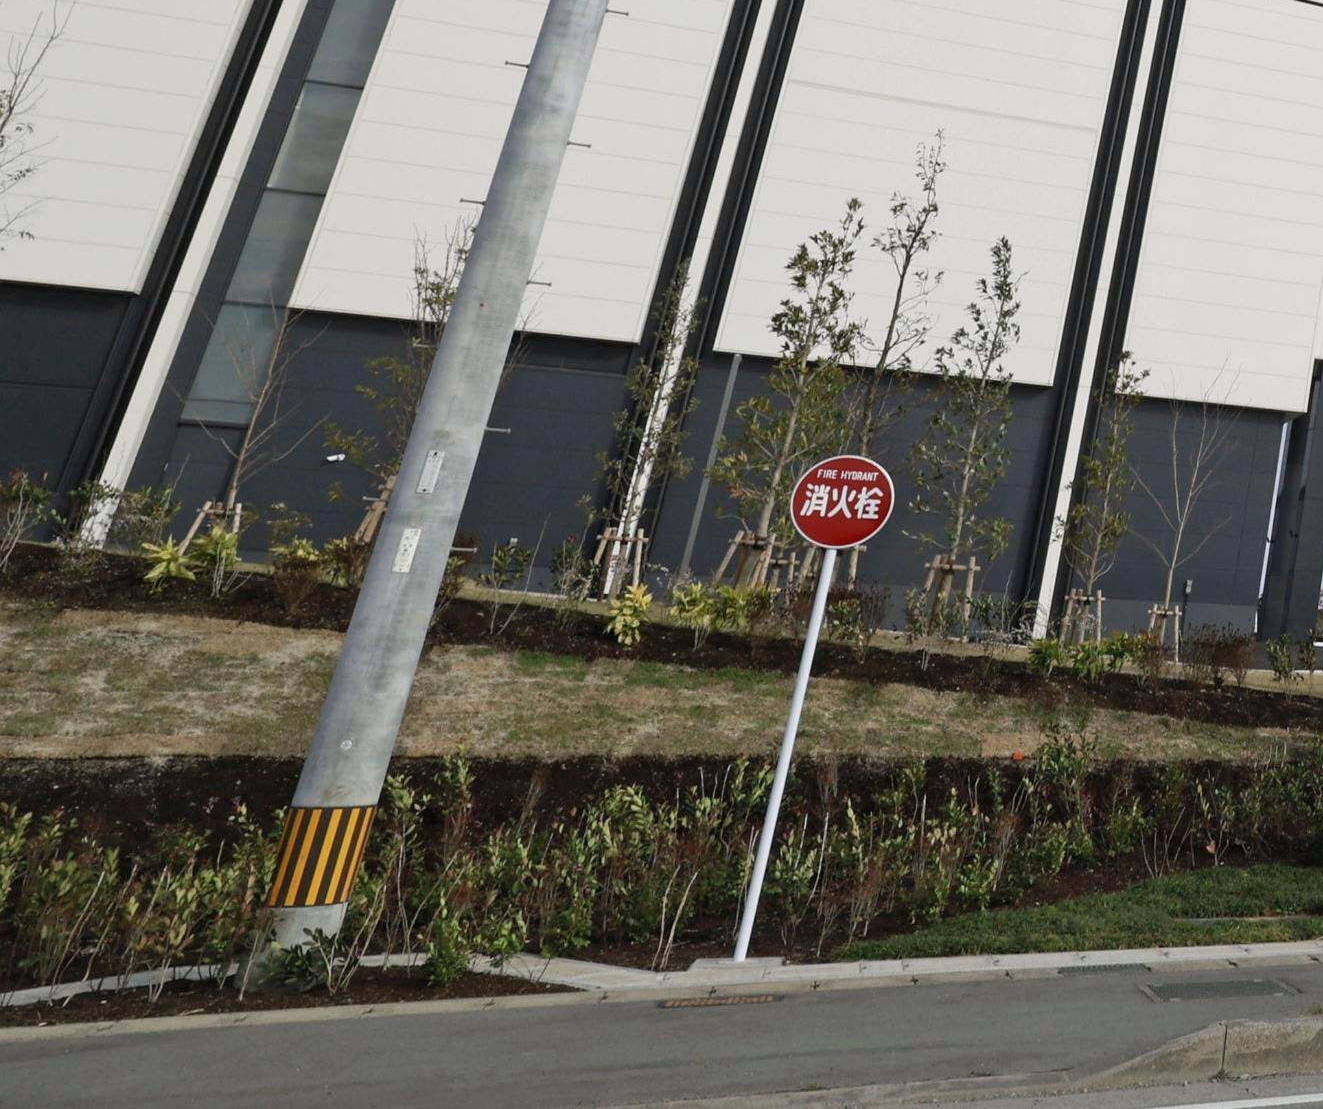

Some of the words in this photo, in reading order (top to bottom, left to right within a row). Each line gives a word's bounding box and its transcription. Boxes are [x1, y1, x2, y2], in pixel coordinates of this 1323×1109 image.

[817, 469, 838, 479] FIRE
[841, 471, 879, 481] HYDRANT
[800, 483, 884, 520] 消火栓
